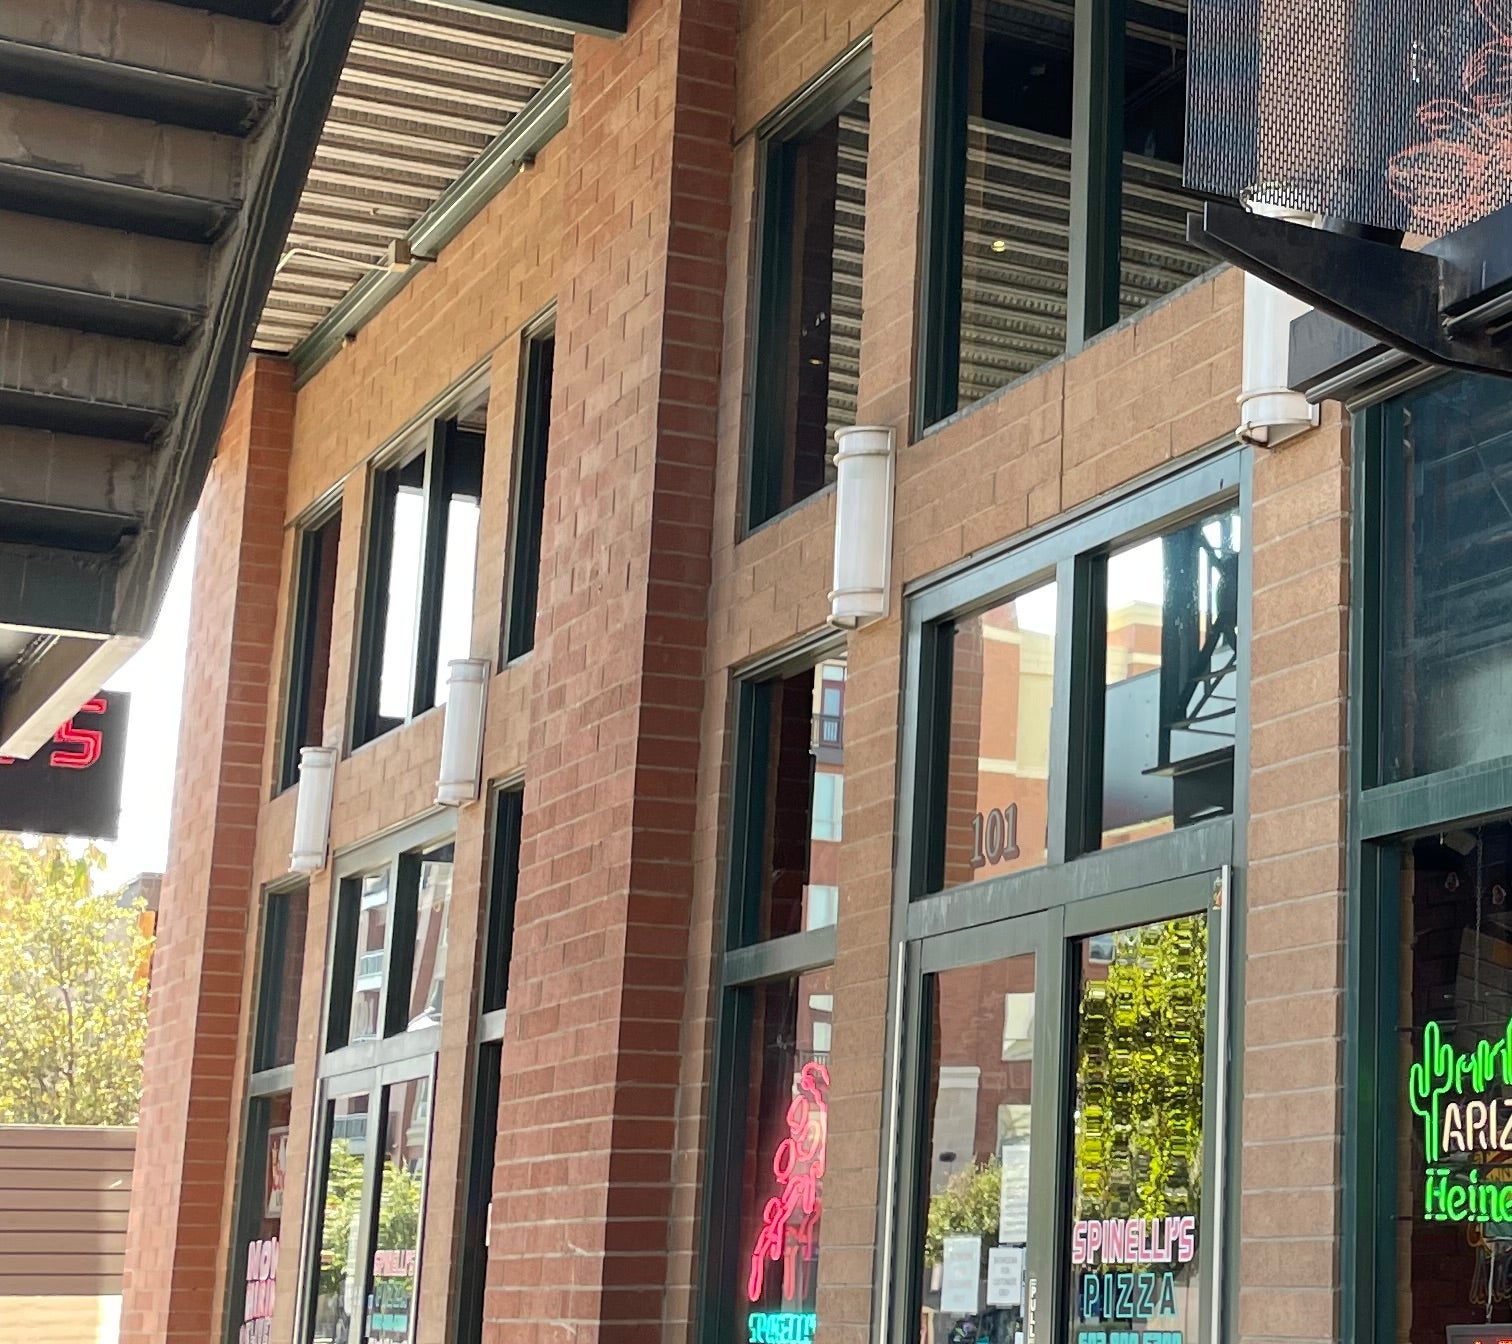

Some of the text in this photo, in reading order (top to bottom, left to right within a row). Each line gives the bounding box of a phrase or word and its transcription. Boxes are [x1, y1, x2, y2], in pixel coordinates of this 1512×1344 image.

[969, 802, 1020, 869] 101
[1072, 1216, 1195, 1265] SPINELLI'S
[1083, 1271, 1178, 1319] PIZZA
